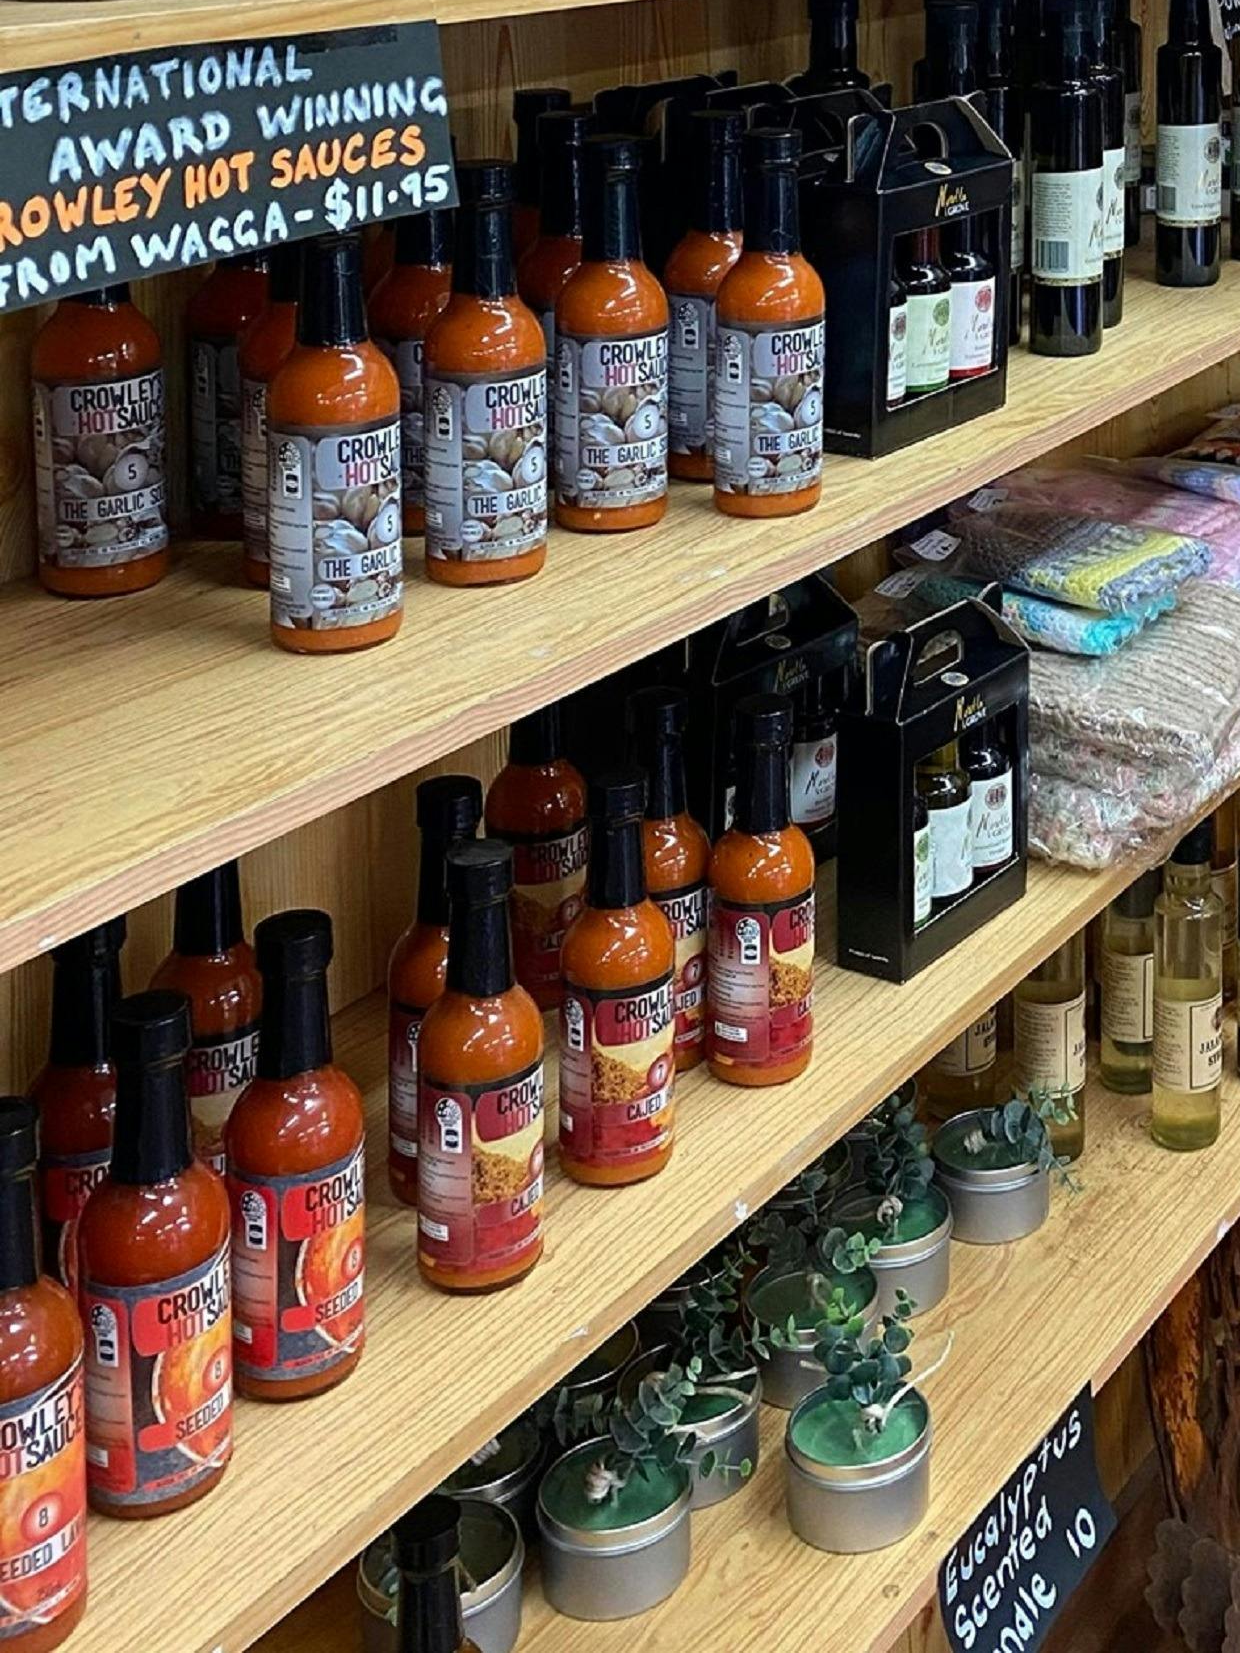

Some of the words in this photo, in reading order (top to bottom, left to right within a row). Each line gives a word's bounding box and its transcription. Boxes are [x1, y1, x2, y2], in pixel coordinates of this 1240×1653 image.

[0, 44, 313, 129] TERNATIONAL
[48, 111, 232, 185] AWARD
[256, 76, 449, 141] WINNING
[184, 151, 255, 210] HOT
[270, 124, 427, 190] SAUCES
[810, 399, 817, 416] 5
[644, 413, 652, 430] 5
[586, 446, 610, 465] THE
[617, 440, 657, 464] GARLIC
[758, 434, 781, 452] THE
[127, 463, 137, 480] 5
[531, 457, 539, 474] 5
[63, 500, 88, 521] THE
[97, 493, 145, 519] GARLIC
[471, 496, 498, 516] THE
[506, 486, 543, 511] GARLIC
[387, 513, 394, 533] 5
[324, 558, 351, 579] THE
[656, 1062, 665, 1082] 7
[626, 1096, 661, 1120] CAJED
[510, 1186, 540, 1216] CAJED
[350, 1251, 358, 1268] 8
[314, 1280, 361, 1322] SEEDED
[214, 1360, 223, 1380] 8
[176, 1392, 225, 1439] SEEDED
[38, 1507, 49, 1528] 8
[945, 1409, 1082, 1605] Eucalyptus
[1066, 1507, 1096, 1559] 10
[954, 1495, 1053, 1649] Scented
